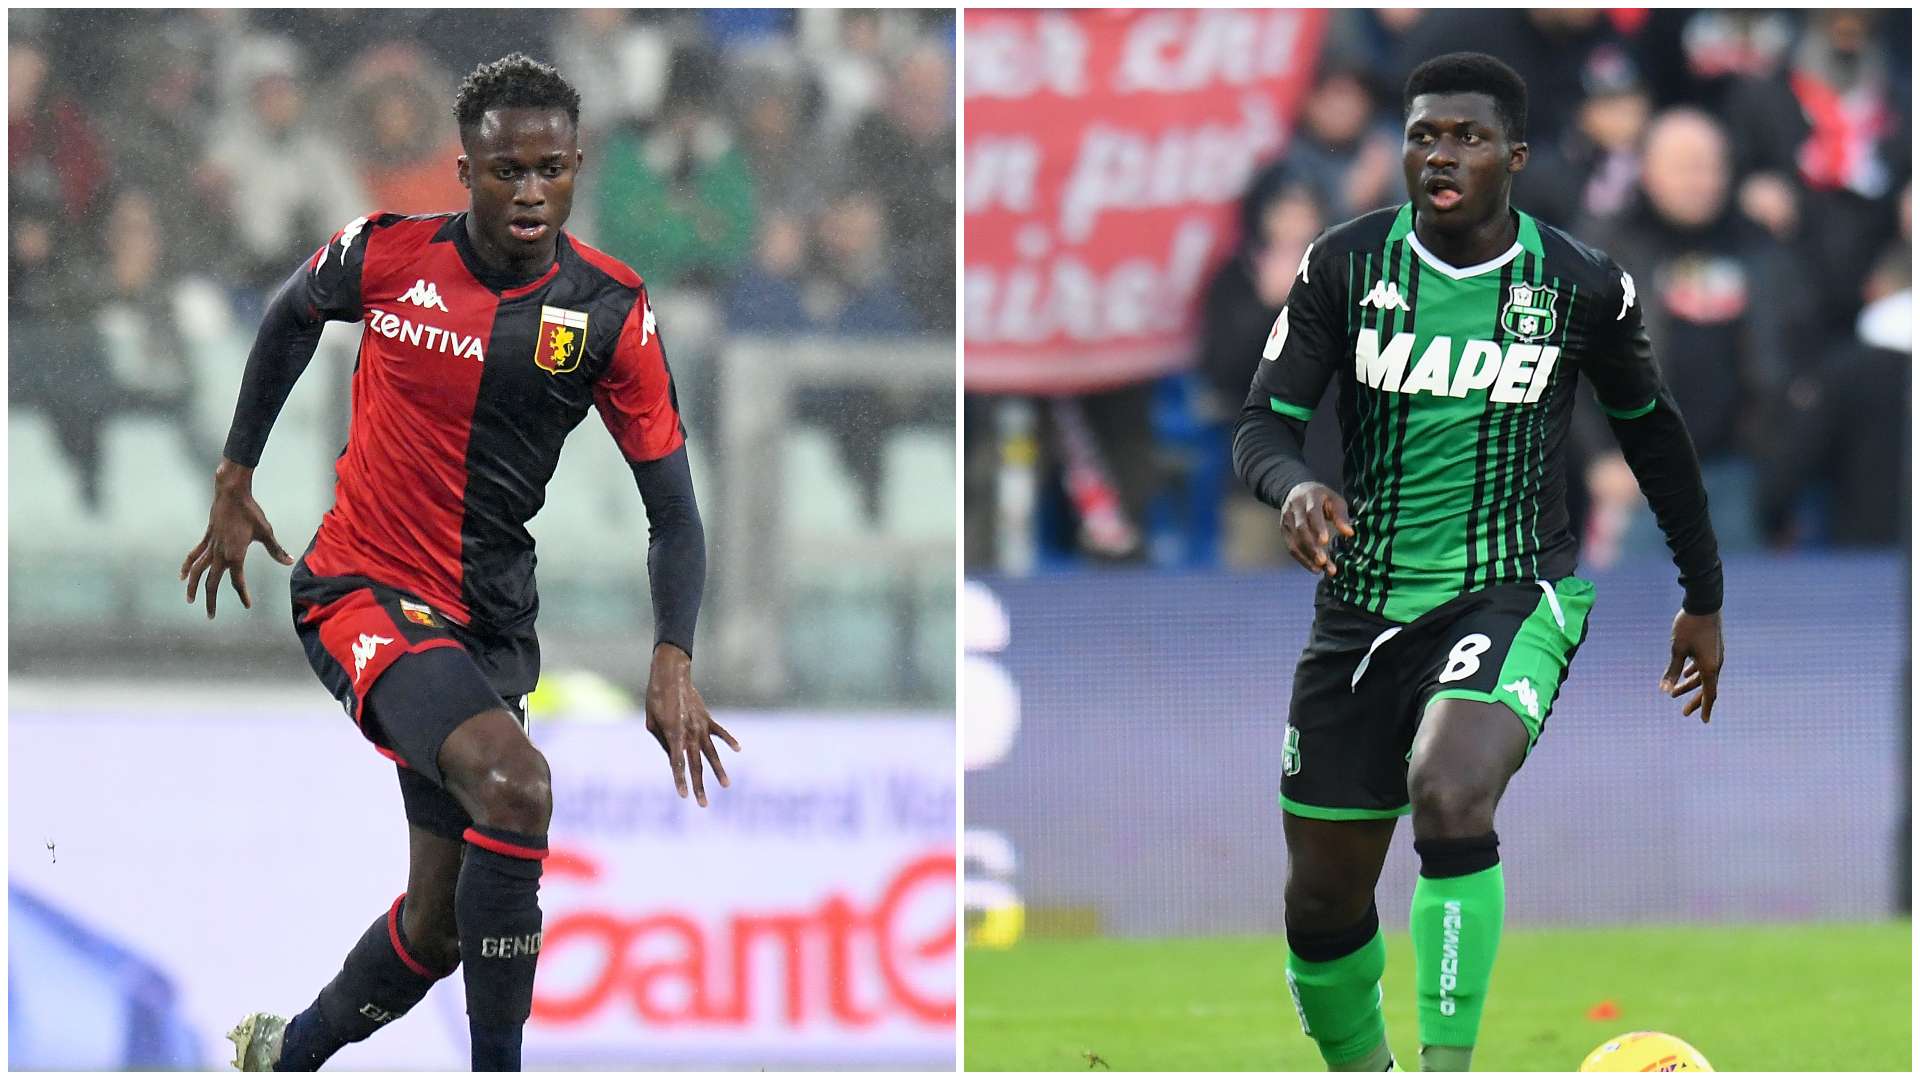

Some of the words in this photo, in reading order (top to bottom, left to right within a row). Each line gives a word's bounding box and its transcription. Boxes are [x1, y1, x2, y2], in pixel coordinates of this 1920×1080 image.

[1355, 328, 1560, 403] MAPEI
[1439, 633, 1492, 684] 8
[1440, 900, 1461, 1017] SASSUOLO
